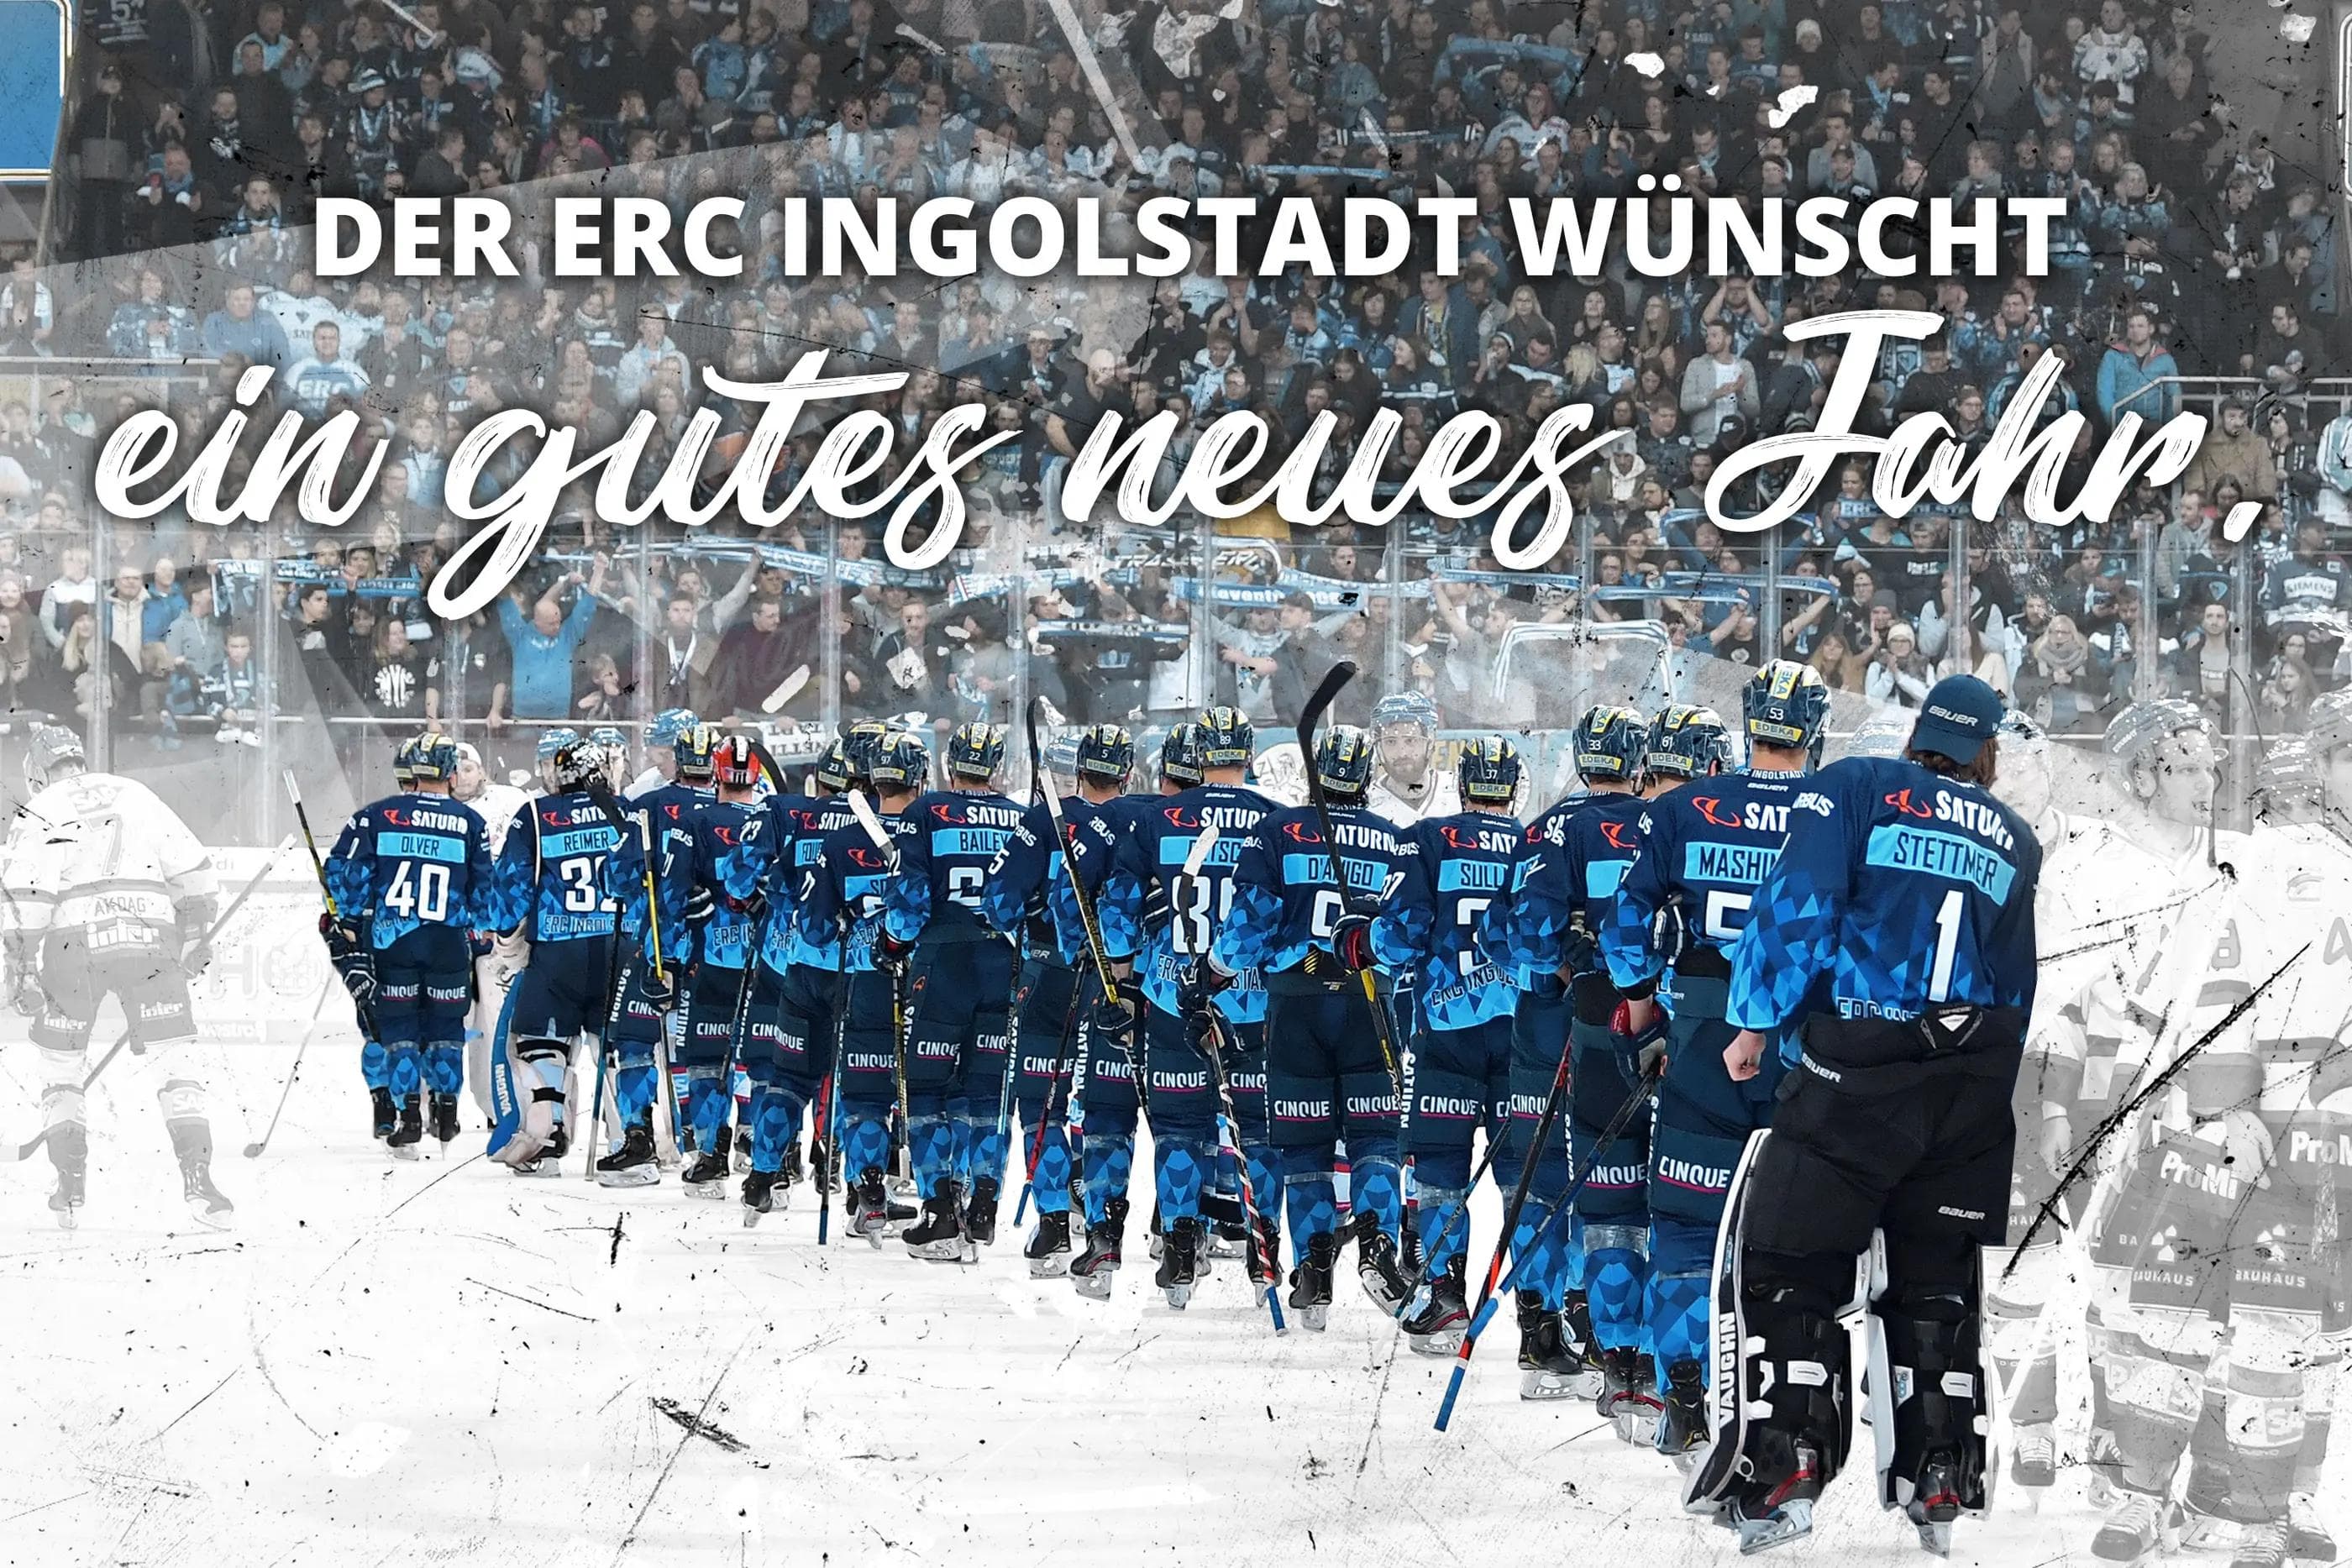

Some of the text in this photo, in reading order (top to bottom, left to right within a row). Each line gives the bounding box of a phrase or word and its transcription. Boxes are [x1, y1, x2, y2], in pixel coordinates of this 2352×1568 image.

[1769, 708, 1784, 721] 53
[1929, 705, 1979, 727] BAUER
[1755, 721, 1795, 737] EDEKA
[1220, 736, 1231, 746] 89
[1588, 739, 1602, 751] 33
[1662, 736, 1674, 747] 61
[969, 752, 981, 761] 22
[1101, 750, 1109, 758] 5
[1581, 756, 1615, 767] EDEKA
[1652, 754, 1688, 766] EDEKA
[827, 763, 839, 773] 23
[1338, 767, 1346, 778] 9
[1485, 769, 1498, 780] 37
[570, 806, 607, 824] SAT
[966, 805, 1025, 827] SATUR
[1200, 807, 1268, 830] SATUR
[1745, 803, 1791, 832] SAT
[402, 836, 439, 856] OLVER
[564, 830, 609, 852] REIMER
[960, 830, 1009, 852] BAILEY
[1322, 823, 1395, 852] ATURN
[1478, 830, 1517, 854] SAT
[1699, 846, 1782, 880] MASHIN
[1893, 831, 1998, 892] STETTMER
[1308, 857, 1374, 886] D'AIGO
[385, 861, 451, 922] 40
[714, 925, 740, 947] ERC
[1929, 889, 1964, 1003] 1
[427, 984, 467, 1001] CINQUE
[609, 962, 632, 1023] SATURN
[627, 1000, 658, 1017] CIN
[696, 1021, 732, 1036] CINQ
[751, 1023, 776, 1038] CIN
[976, 1034, 1008, 1051] CINQ
[847, 1053, 895, 1068] CINQUE
[1095, 1059, 1131, 1079] CINQ
[1801, 1052, 1841, 1083] BAUER
[1152, 1070, 1207, 1088] CINQUE
[1230, 1072, 1266, 1089] CINQ
[1273, 1099, 1331, 1118] CINQUE
[1347, 1095, 1399, 1114] CINQUE
[1420, 1095, 1478, 1112] CINQUE
[1511, 1093, 1551, 1109] CINQU
[2290, 1130, 2352, 1167] ProM
[1658, 1155, 1731, 1188] CINQUE
[2160, 1150, 2239, 1199] ProMi
[1938, 1205, 1986, 1220] BAUER
[2133, 1270, 2194, 1287] BAUHAUS
[2235, 1270, 2306, 1288] BAUHAUS
[1719, 1312, 1735, 1429] VAUGHN
